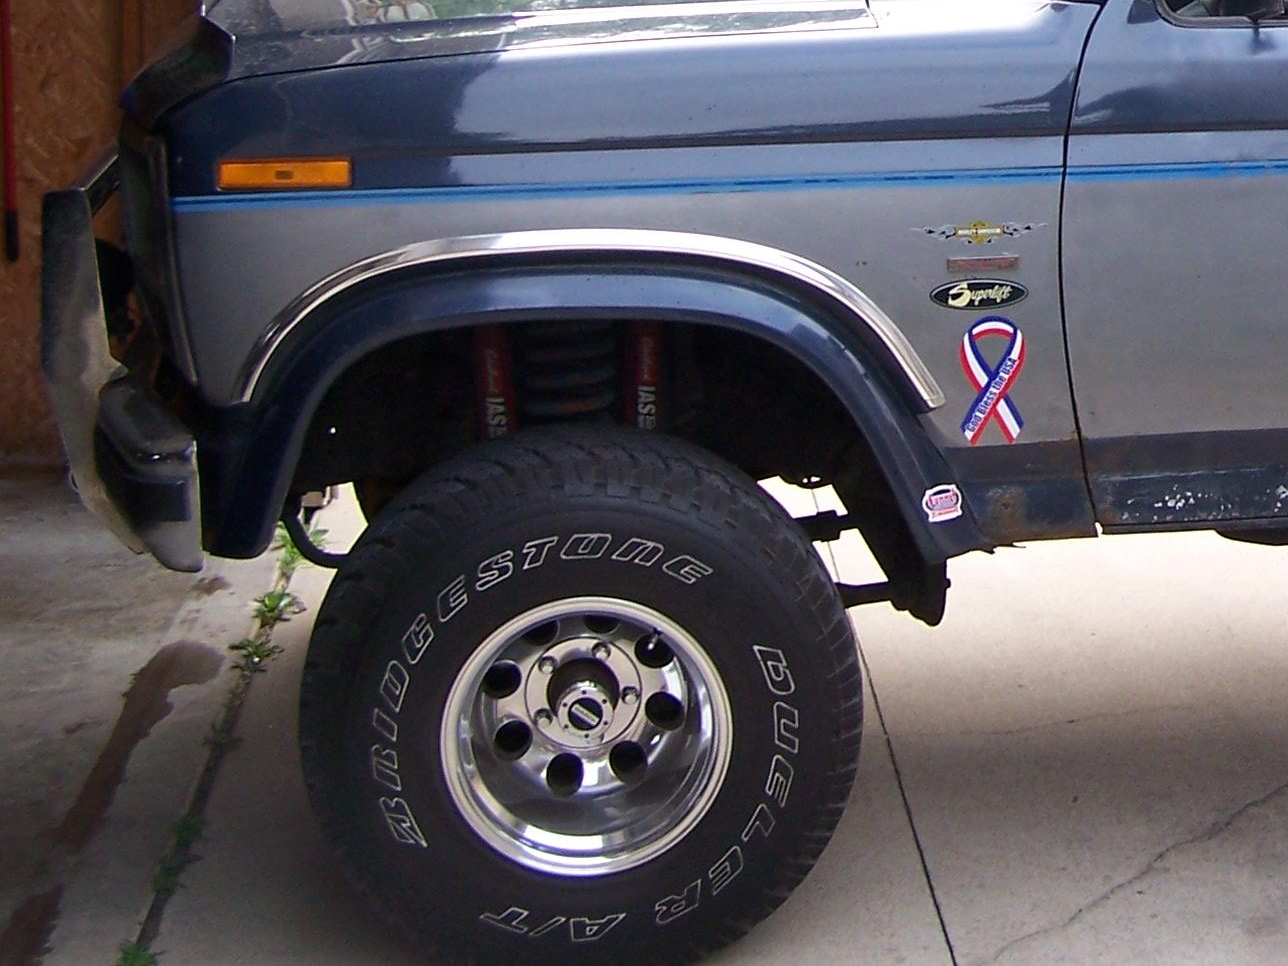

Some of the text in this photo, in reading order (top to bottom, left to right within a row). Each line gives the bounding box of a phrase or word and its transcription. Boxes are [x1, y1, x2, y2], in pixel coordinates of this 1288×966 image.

[948, 282, 1014, 307] Superlift
[966, 414, 983, 432] God
[977, 390, 997, 415] Bless
[1001, 357, 1018, 375] USA
[370, 533, 714, 848] BRIDGESTONE
[479, 644, 800, 942] DUELER A/T
